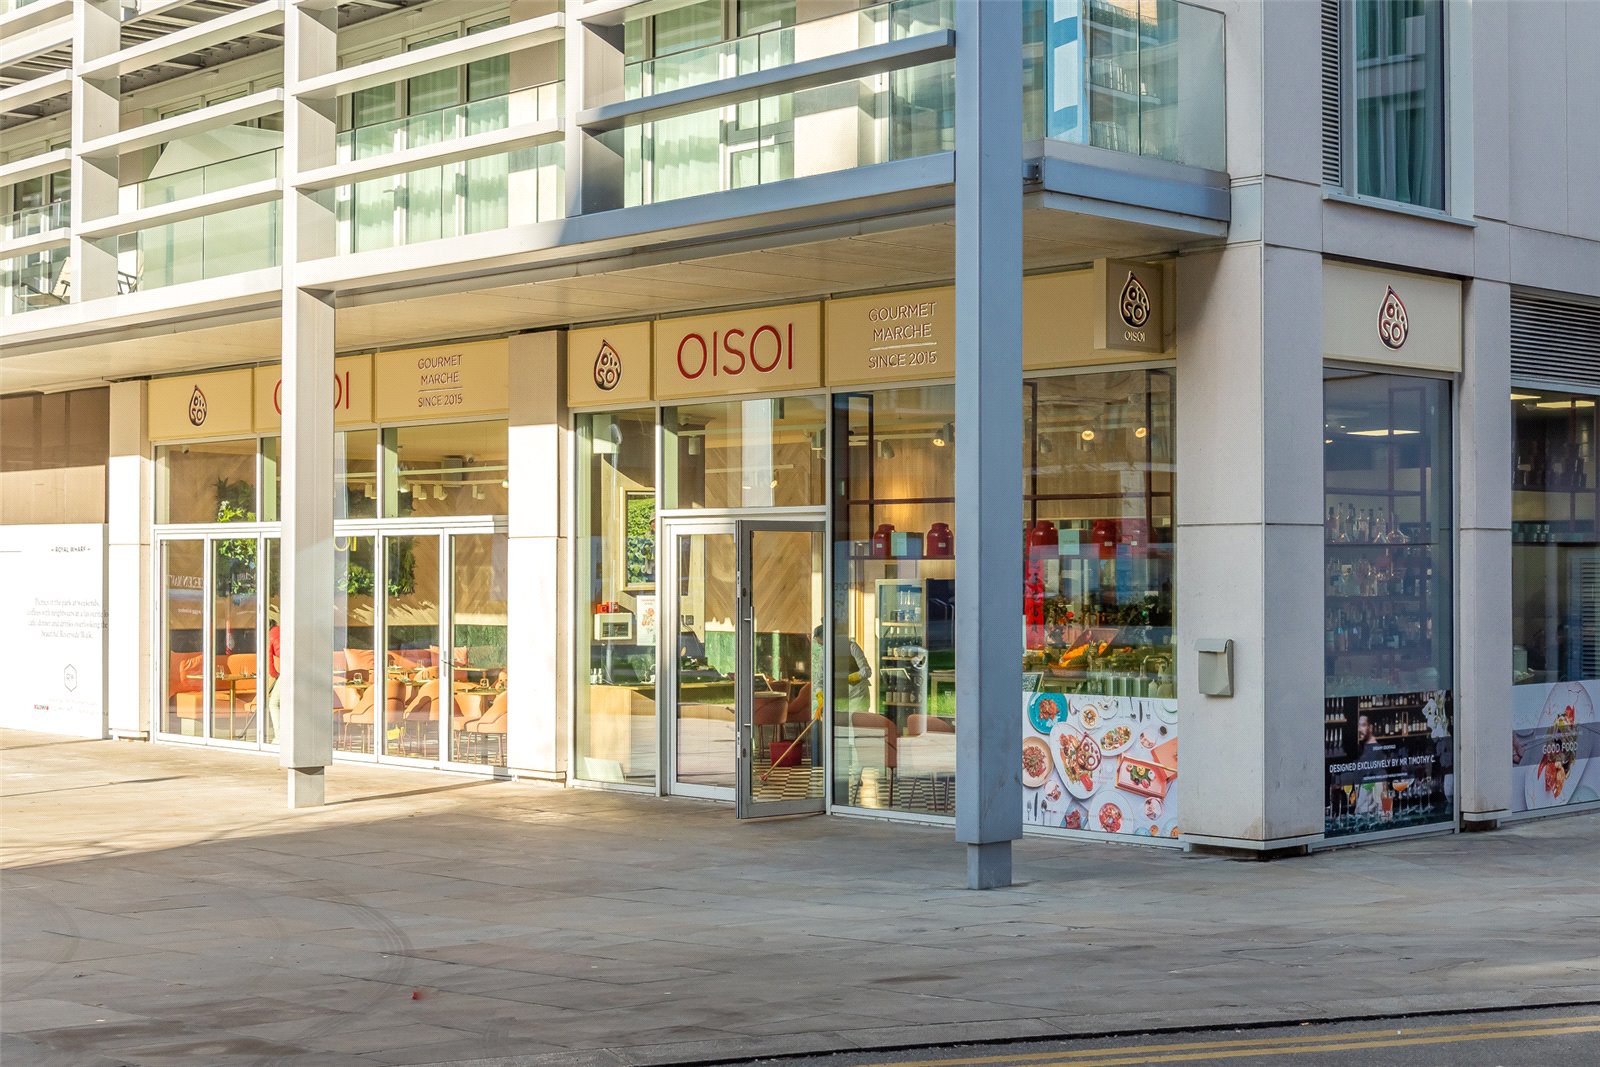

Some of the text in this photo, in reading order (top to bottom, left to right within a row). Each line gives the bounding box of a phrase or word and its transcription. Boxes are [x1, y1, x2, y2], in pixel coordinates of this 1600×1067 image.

[868, 302, 938, 323] GOURMET
[873, 323, 932, 342] MARCHE
[1124, 331, 1146, 342] OISOI
[677, 323, 793, 380] OISOI
[417, 354, 463, 370] GOURMET
[868, 351, 938, 370] SINCE 2015
[420, 371, 460, 385] MARCHE
[417, 393, 463, 408] SINCE 2015
[1542, 741, 1578, 755] GOOD FOOD
[1329, 762, 1356, 774] DESIGNED
[1357, 760, 1391, 771] EXCLUSIVELY
[1391, 758, 1399, 767] BY
[1399, 757, 1408, 766] MR
[1408, 755, 1431, 765] TIMOTHY
